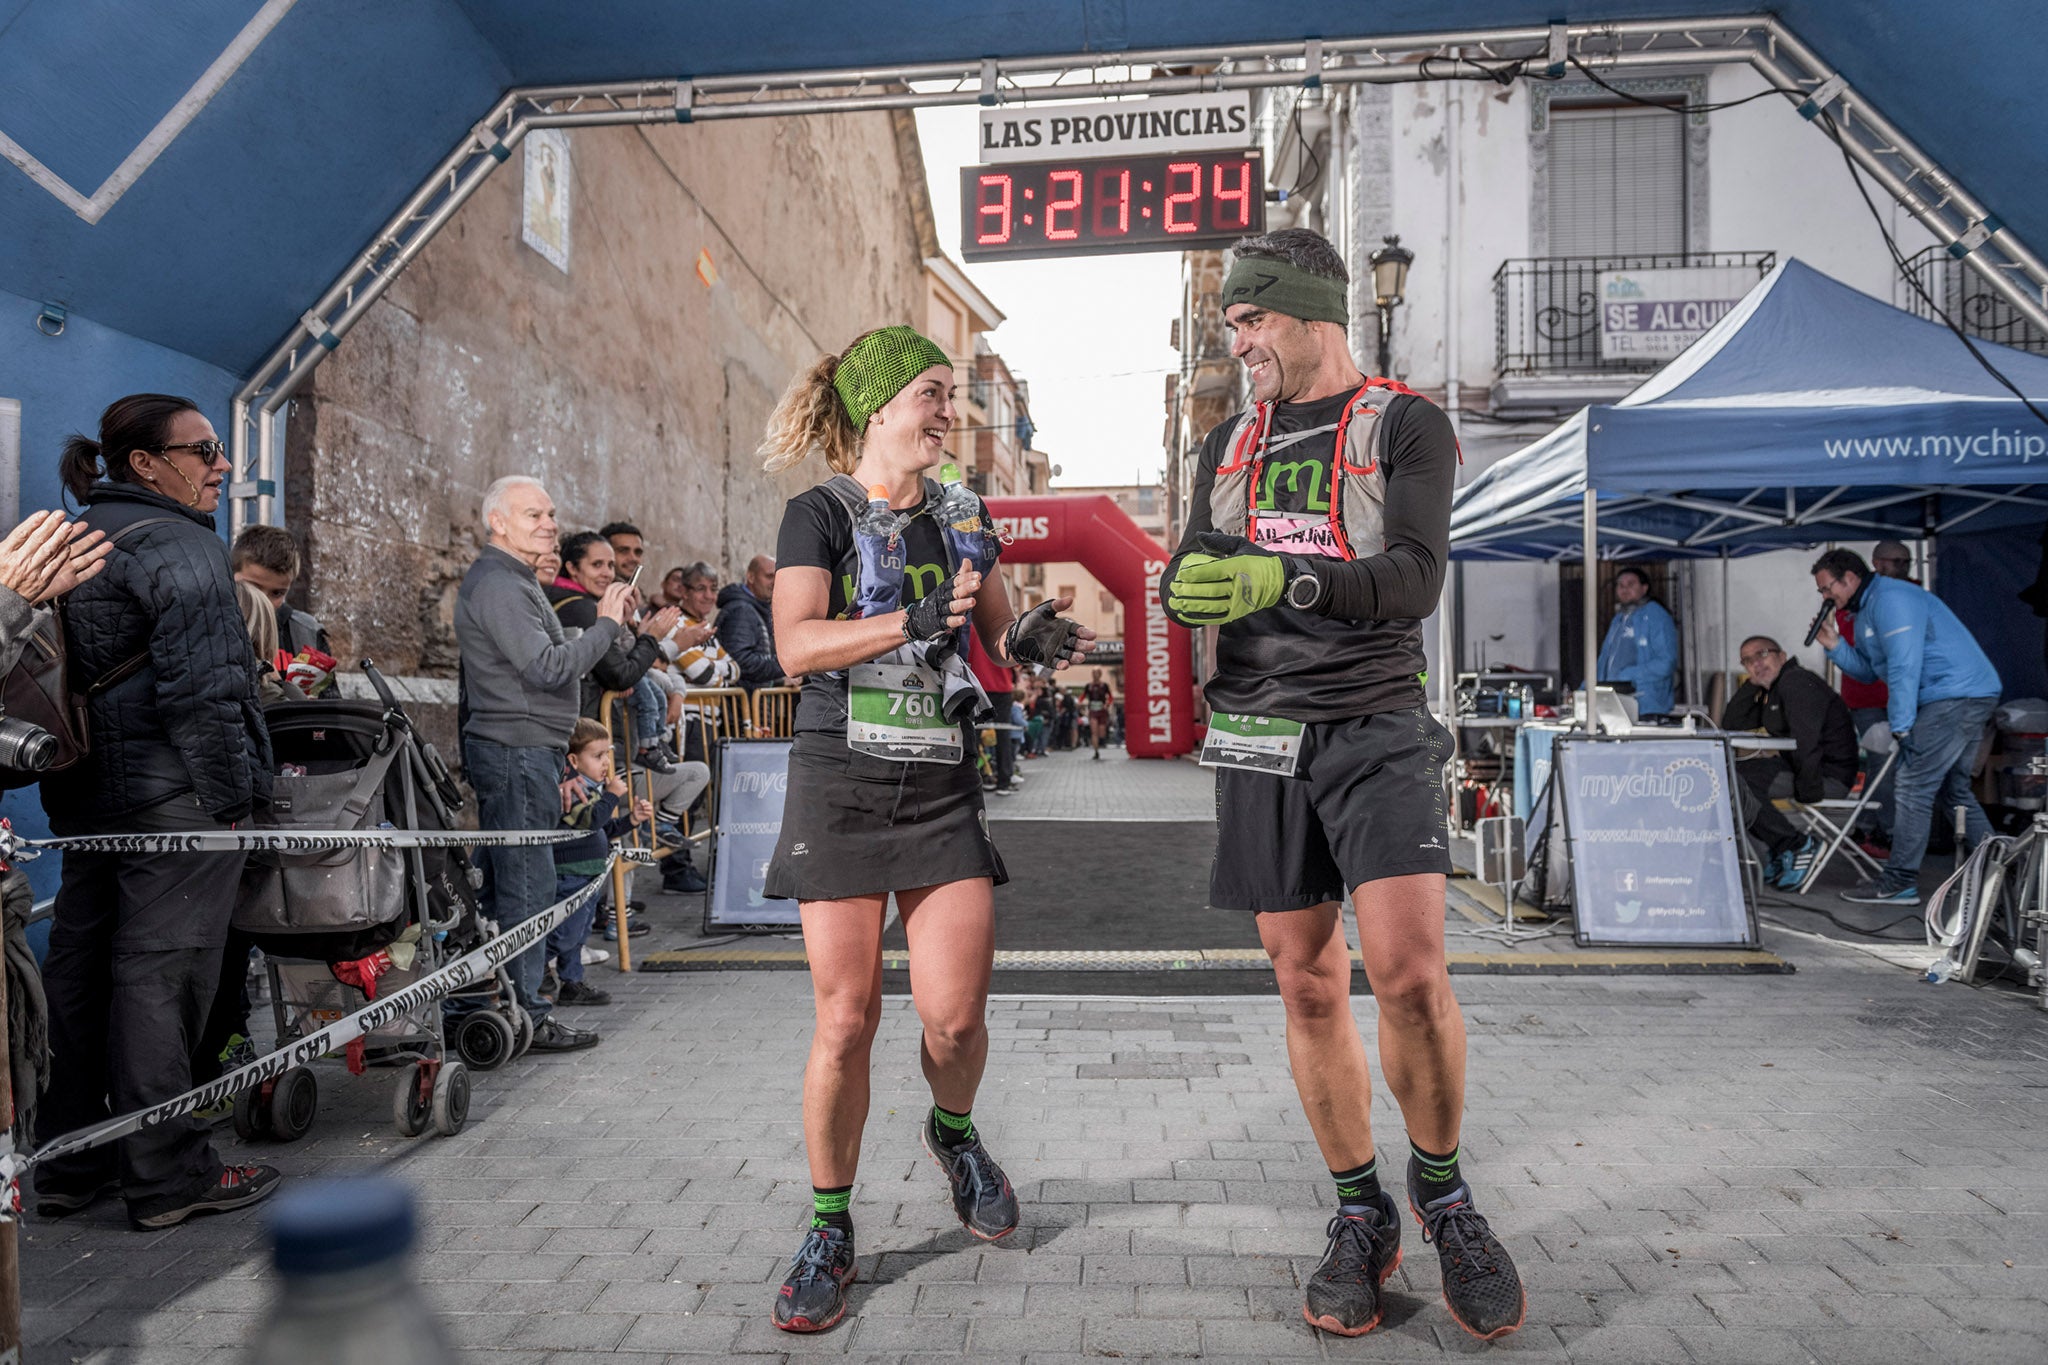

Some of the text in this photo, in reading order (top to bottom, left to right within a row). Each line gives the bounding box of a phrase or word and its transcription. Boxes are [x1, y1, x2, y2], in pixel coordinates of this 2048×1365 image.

[982, 104, 1247, 149] LAS PROVINCIAS
[977, 162, 1251, 245] 3:21:24
[1607, 303, 1640, 331] SE
[1610, 335, 1637, 352] TEL
[1144, 559, 1172, 744] LAS PROVINCIAS
[887, 692, 936, 718] 760
[1580, 767, 1695, 807] mychip
[1582, 827, 1721, 847] www.mychip.es
[485, 910, 555, 969] LAS PROVINCIAS
[358, 961, 474, 1033] LAS PROVINCIAS
[294, 1032, 332, 1064] LAS
